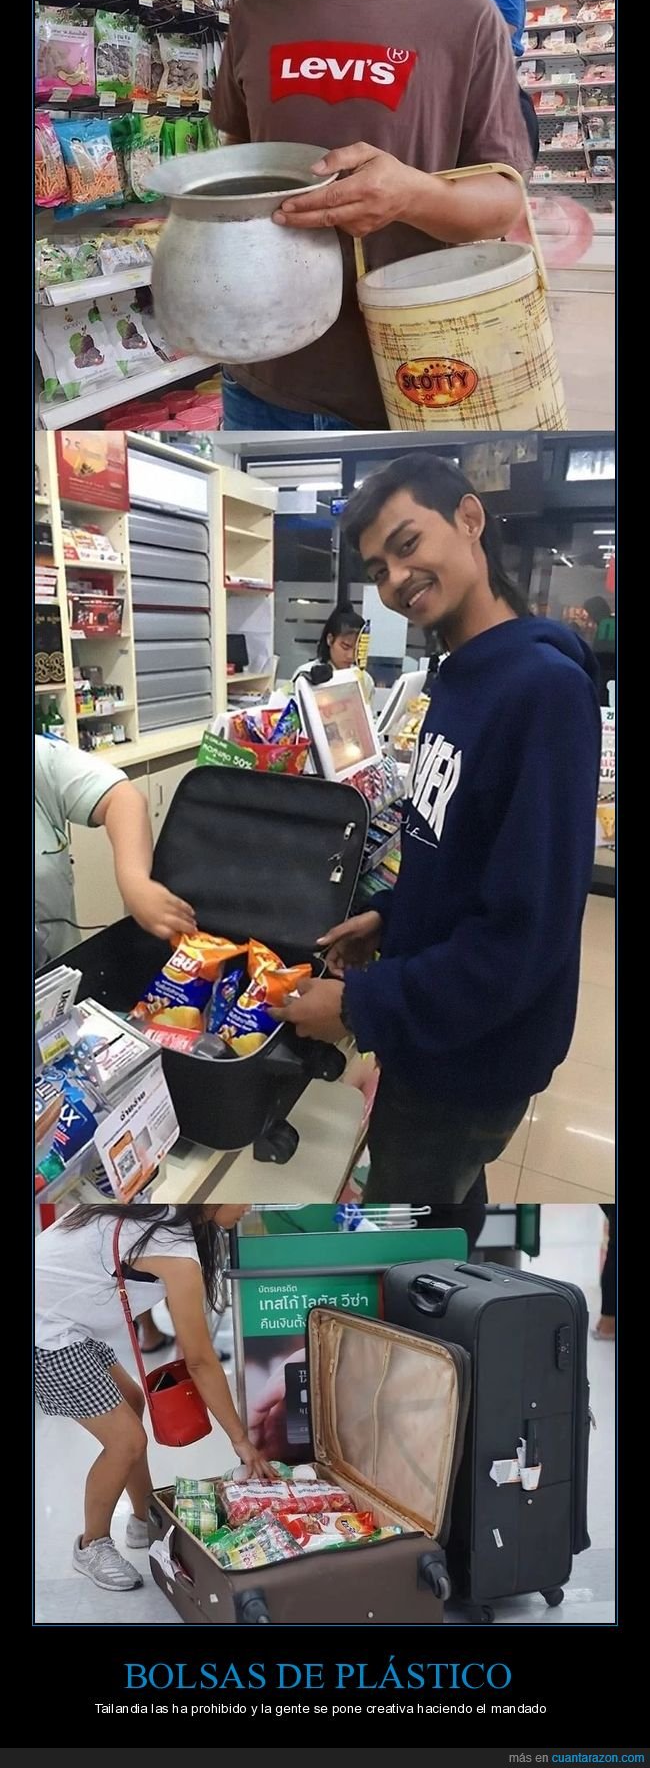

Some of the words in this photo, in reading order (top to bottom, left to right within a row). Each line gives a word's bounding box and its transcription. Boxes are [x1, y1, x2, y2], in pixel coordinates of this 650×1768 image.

[402, 370, 467, 391] SCOTTY
[233, 755, 253, 769] 50%
[258, 1284, 298, 1293] บัตรเครดิต
[259, 1293, 300, 1311] เทสโก้
[342, 1293, 368, 1307] วีซ่า
